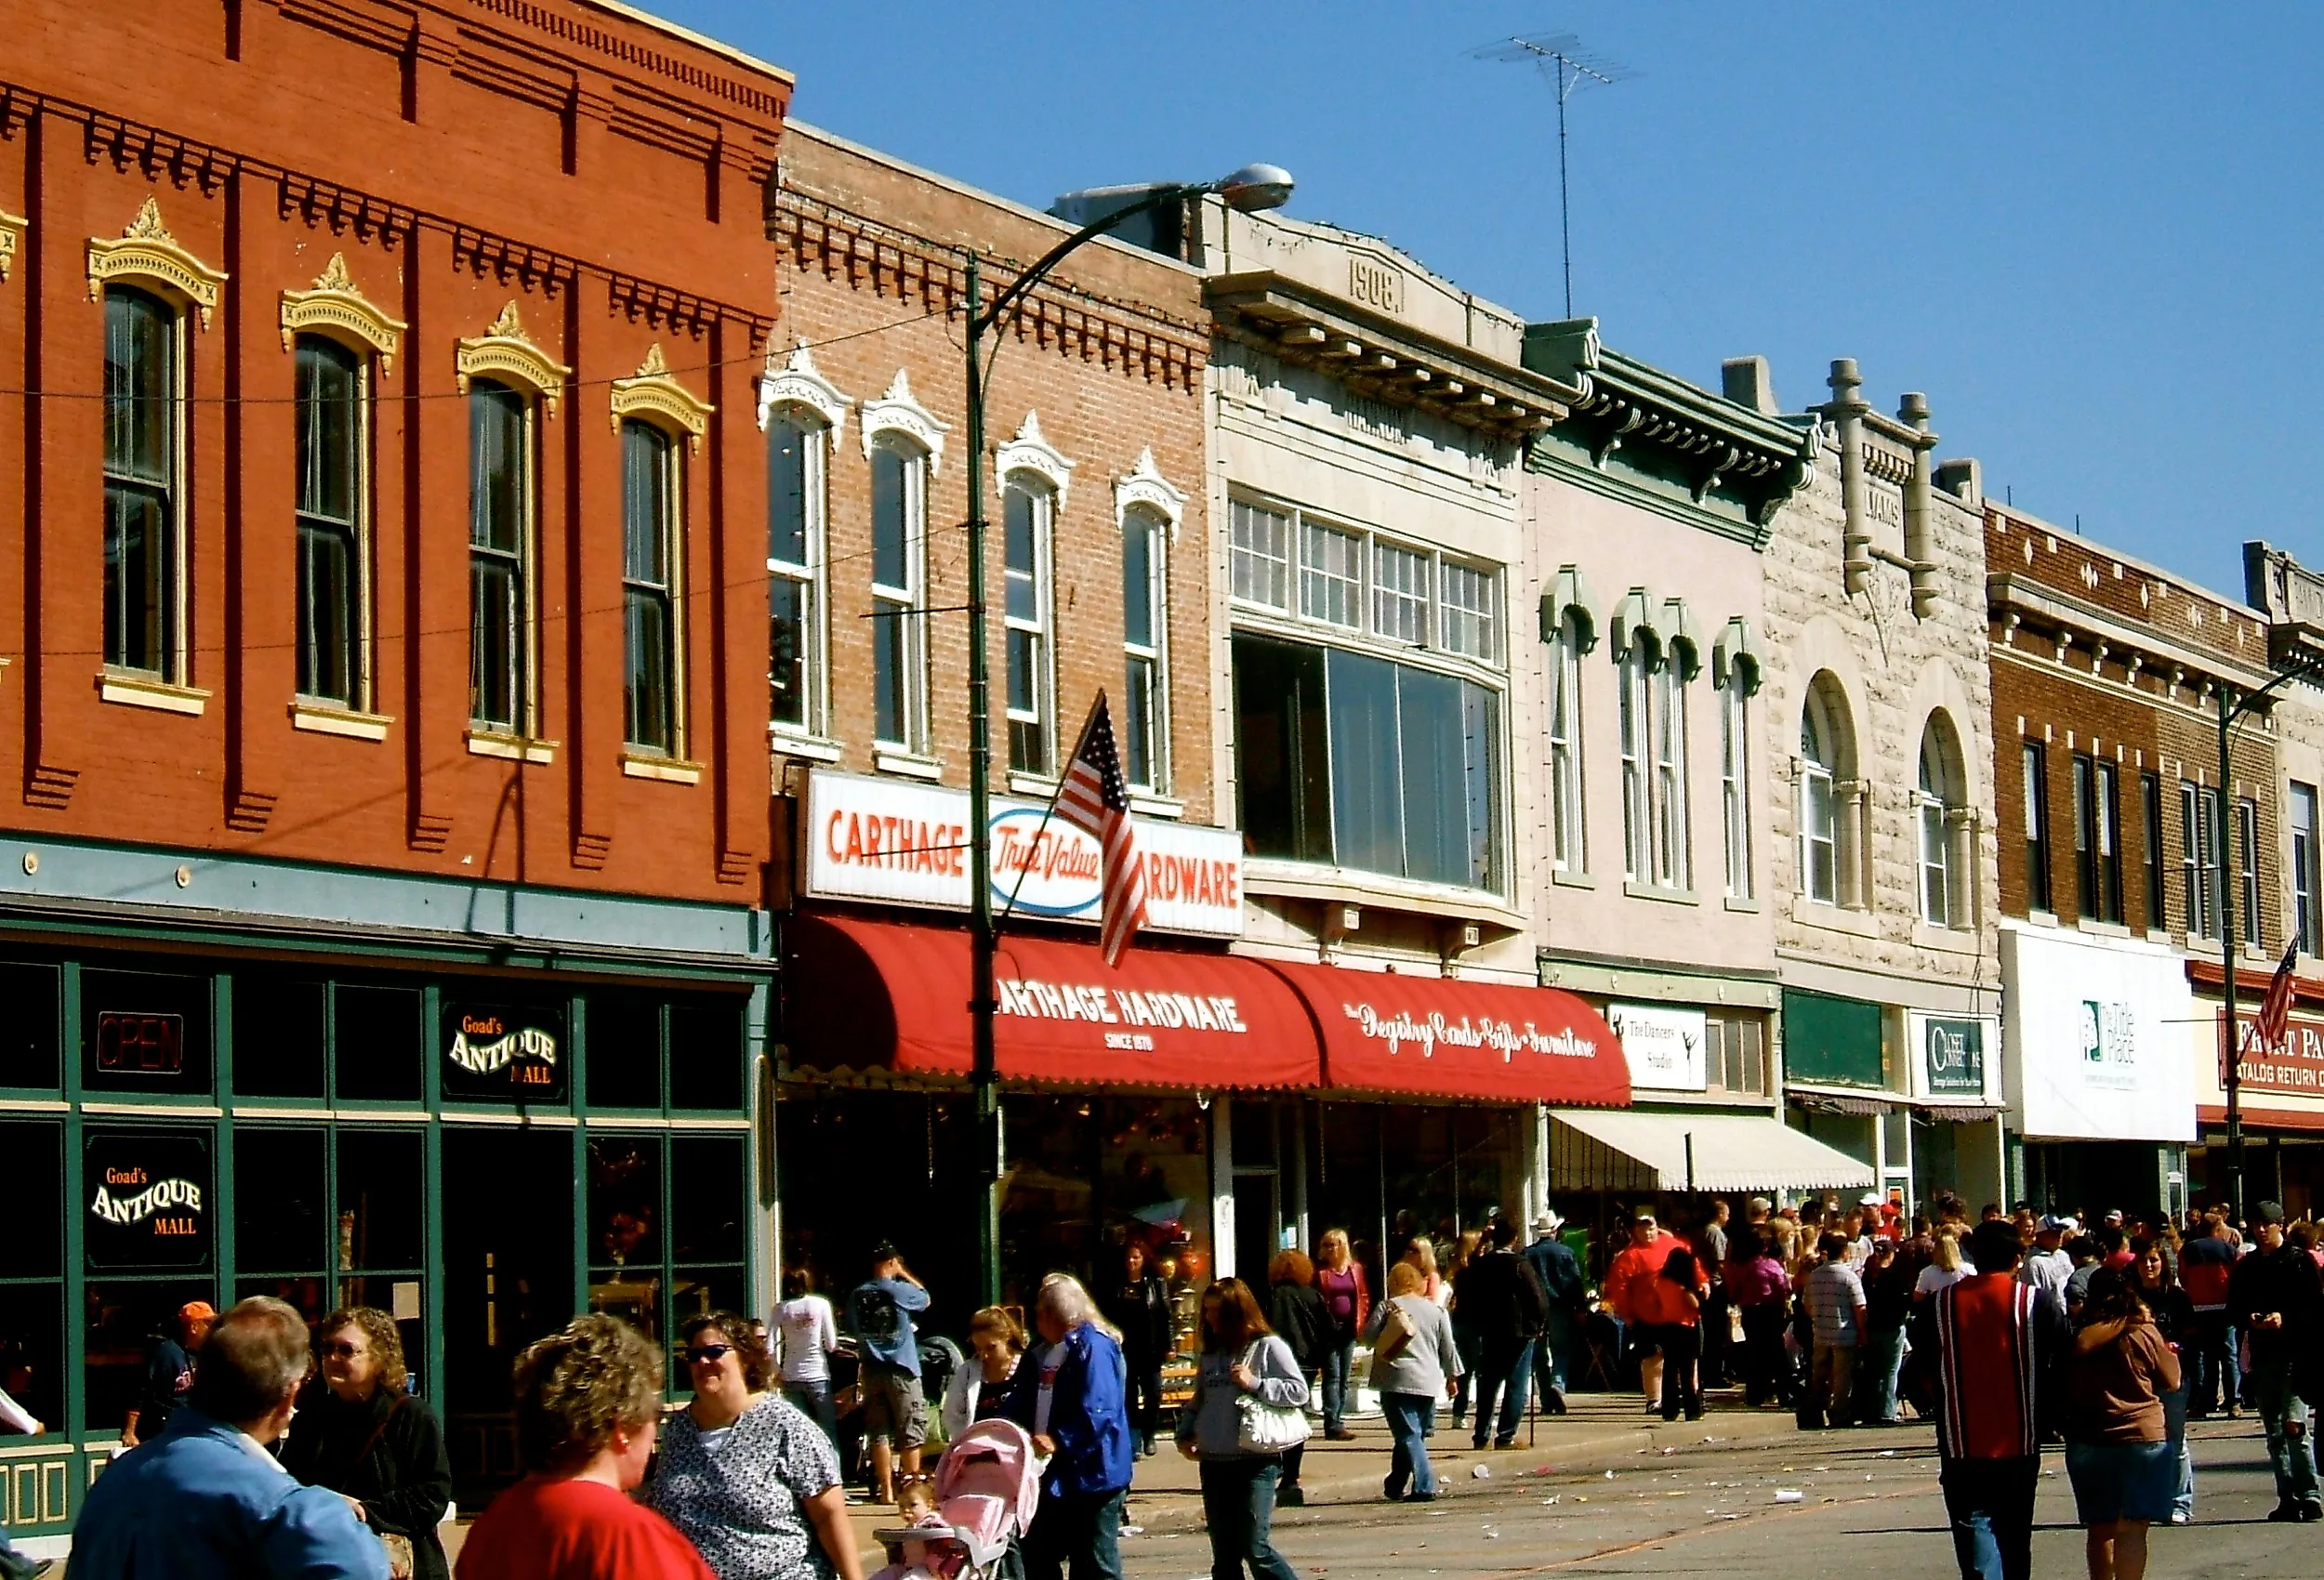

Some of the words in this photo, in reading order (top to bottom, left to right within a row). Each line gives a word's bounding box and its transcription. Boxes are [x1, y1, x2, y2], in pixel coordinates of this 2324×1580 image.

[826, 810, 964, 877] CARTHAGE
[993, 826, 1041, 874] True
[1032, 835, 1098, 881] Value
[1136, 850, 1237, 908] ARDWARE
[462, 1015, 503, 1034] Goad's
[997, 980, 1117, 1023] ARTHAGE
[1113, 989, 1247, 1033] HARDWARE
[2112, 1002, 2134, 1037] Title
[99, 1018, 180, 1069] OPEN
[1358, 1003, 1434, 1058] Registry
[1630, 1020, 1644, 1037] The
[2107, 1029, 2135, 1064] Place
[2237, 1020, 2296, 1057] FRT
[2301, 1028, 2324, 1060] PA
[449, 1027, 558, 1075] ANTIQUE
[2237, 1062, 2274, 1083] ATALOG
[2277, 1066, 2317, 1086] RETURN
[106, 1167, 148, 1184] Goad's
[91, 1178, 202, 1225] ANTIQUE
[154, 1218, 196, 1234] MALL
